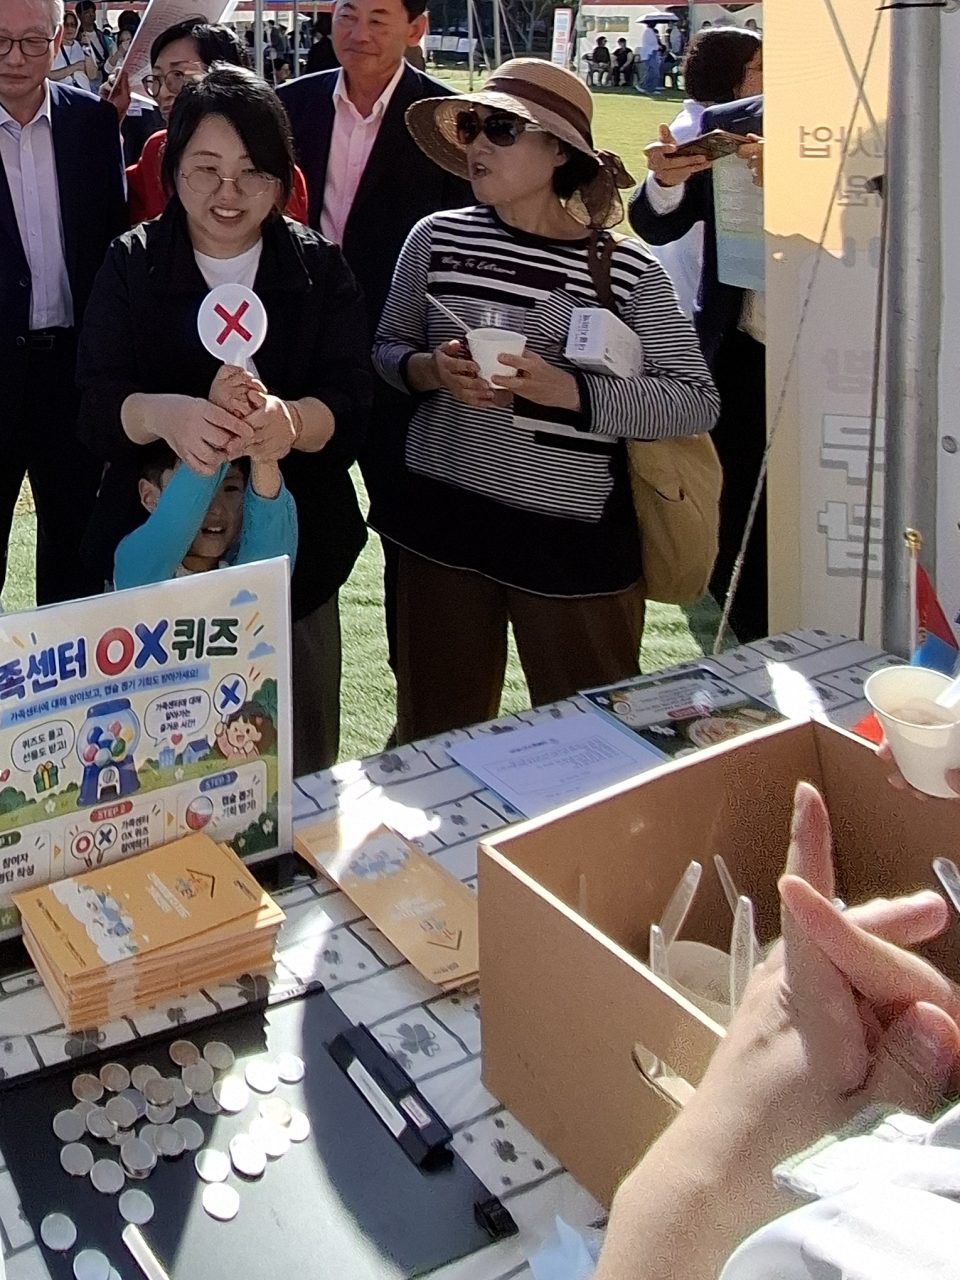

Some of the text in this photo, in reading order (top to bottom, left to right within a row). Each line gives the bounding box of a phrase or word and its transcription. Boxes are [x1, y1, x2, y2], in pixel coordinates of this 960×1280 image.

[51, 696, 67, 709] 대해
[22, 733, 46, 750] 퀴즈도
[3, 852, 28, 869] 참여자
